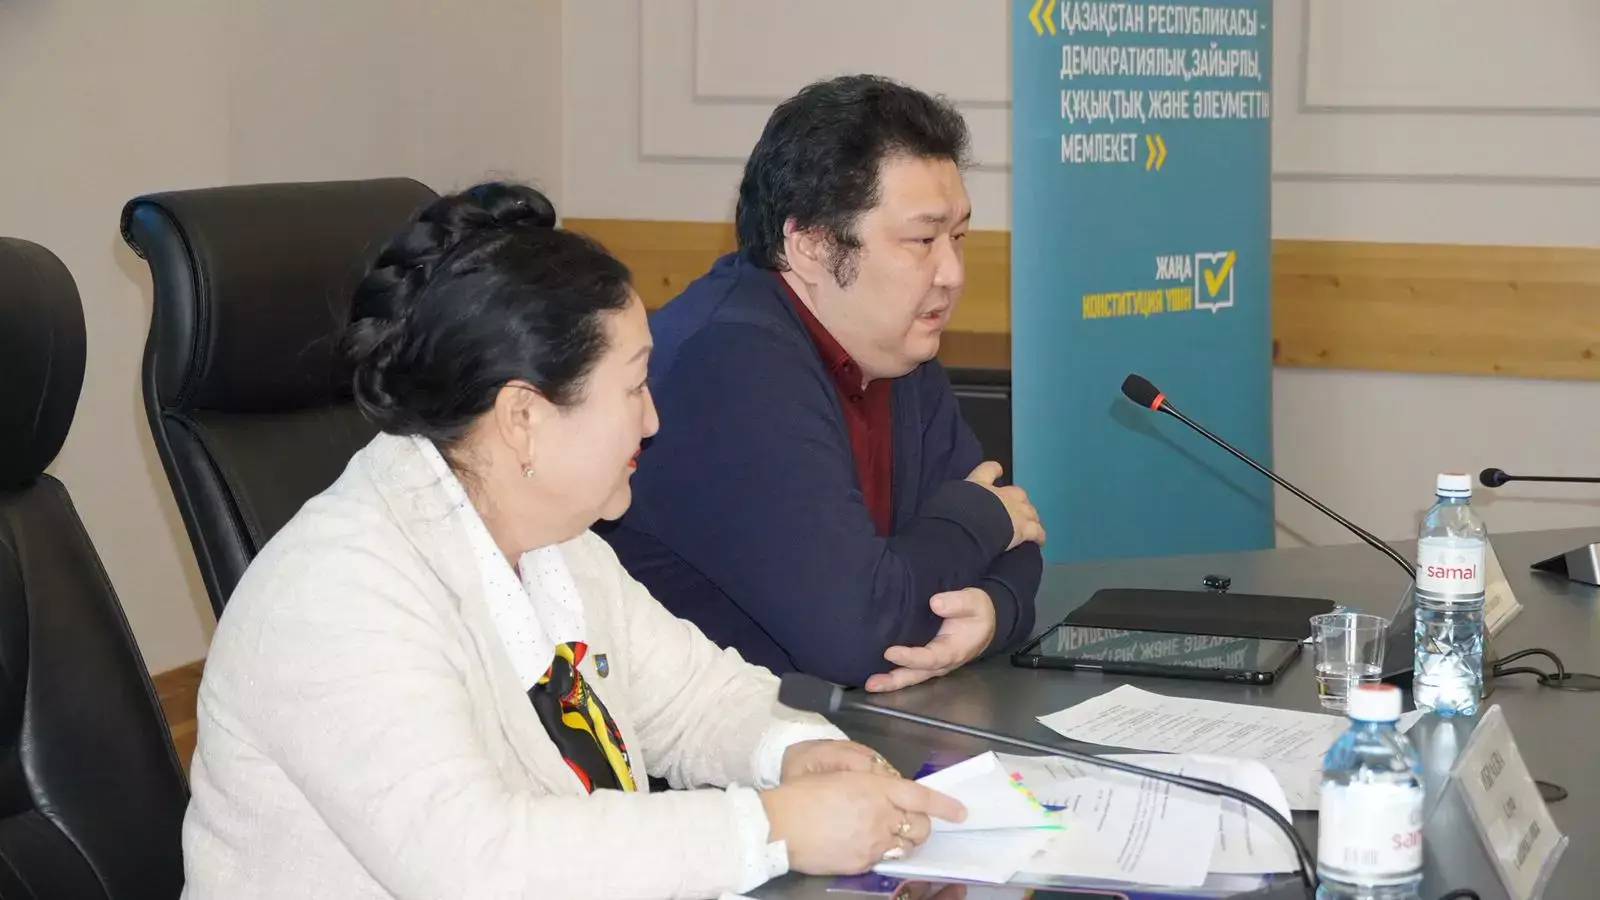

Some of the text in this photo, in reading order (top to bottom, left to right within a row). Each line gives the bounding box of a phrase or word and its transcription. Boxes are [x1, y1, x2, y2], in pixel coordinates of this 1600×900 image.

[1060, 1, 1144, 37] ҚАЗАҚСТАН
[1148, 5, 1258, 36] РЕСПУБЛИКАСЫ
[1148, 89, 1189, 119] ЖӘНЕ
[1061, 133, 1137, 163] МЕМЛЕКЕТ
[1155, 254, 1192, 283] ЖАҢА
[1082, 288, 1162, 320] КОНСТИТУЦИЯ
[1427, 564, 1477, 580] samal
